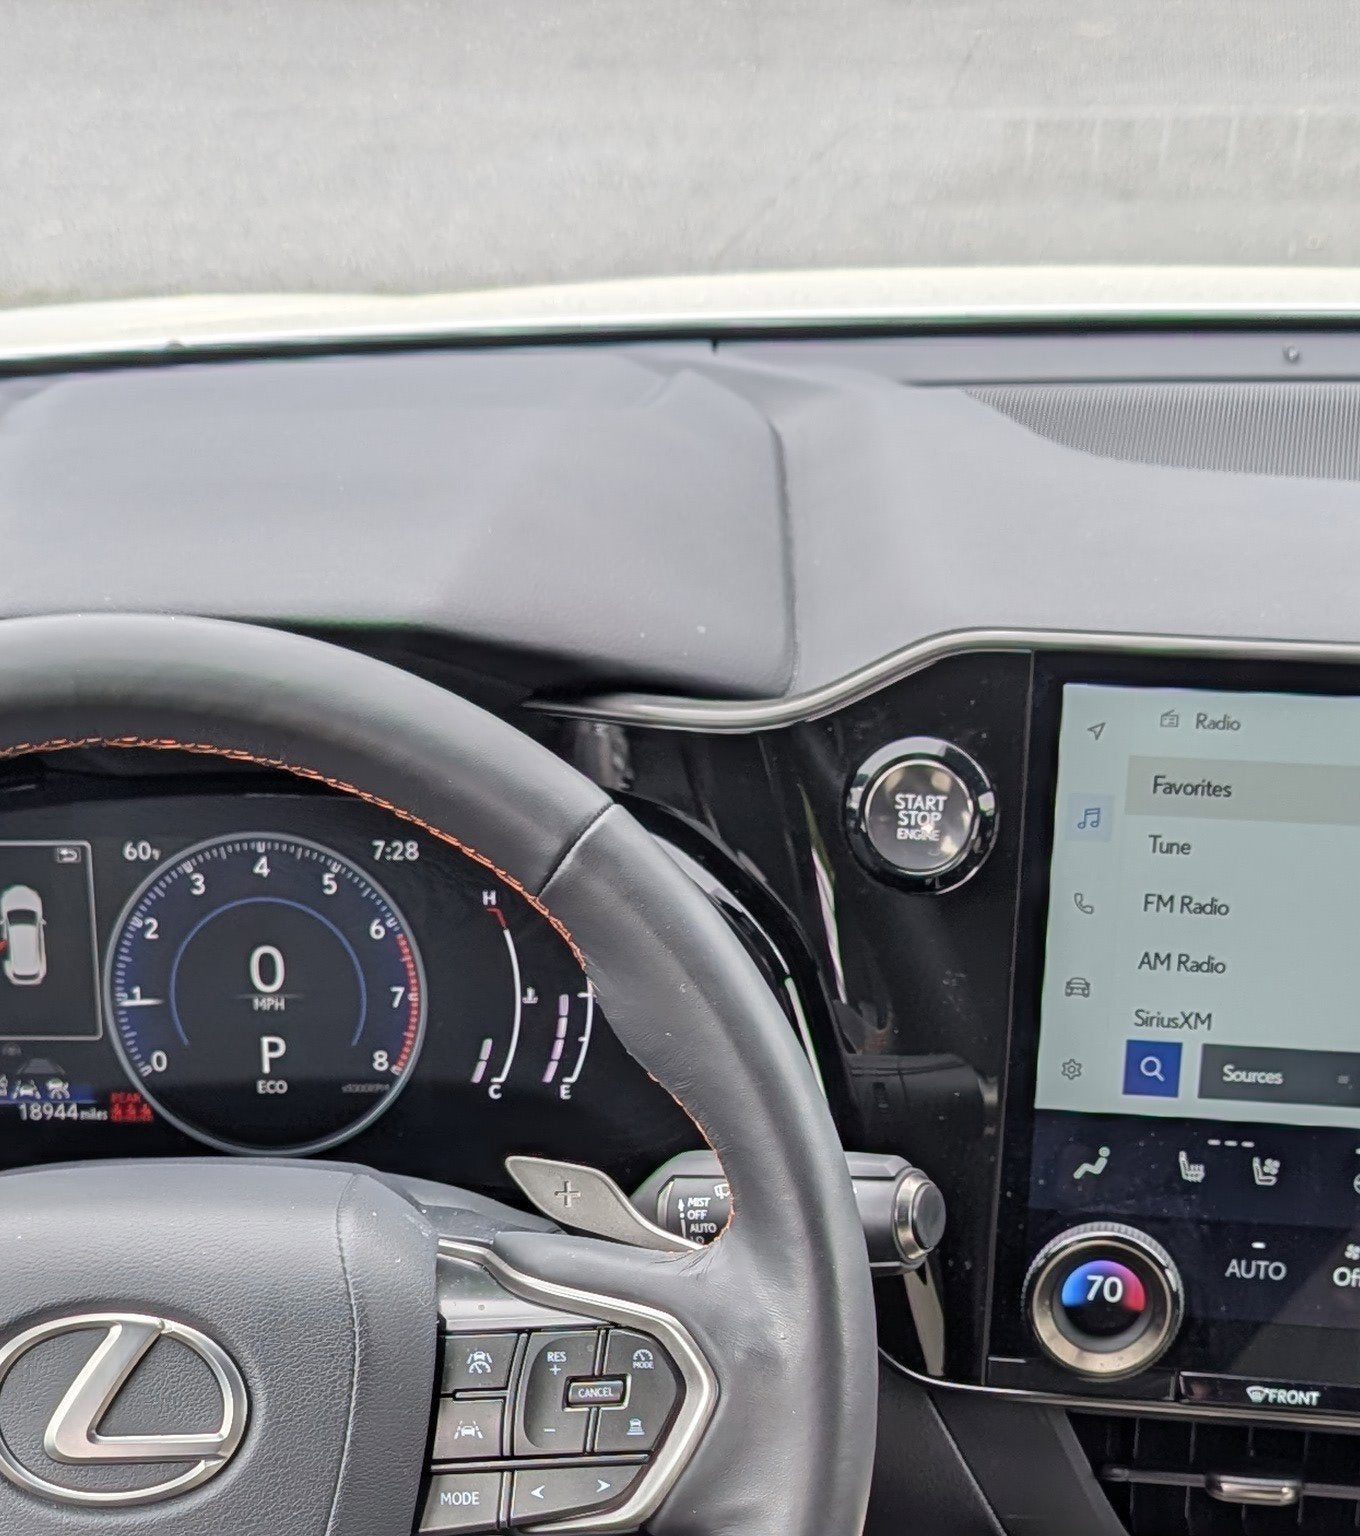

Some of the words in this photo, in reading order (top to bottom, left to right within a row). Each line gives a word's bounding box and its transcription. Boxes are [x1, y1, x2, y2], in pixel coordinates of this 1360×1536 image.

[1195, 712, 1242, 731] Radio
[1152, 775, 1233, 798] Favorites
[894, 793, 948, 812] START
[897, 810, 942, 827] STOP
[896, 828, 940, 842] ENGINE
[1148, 834, 1192, 855] Tune
[372, 840, 419, 861] 7:28
[252, 856, 270, 877] 4
[189, 873, 205, 895] 3
[322, 873, 338, 895] 5
[482, 889, 497, 905] H
[1143, 893, 1175, 914] FM
[1180, 896, 1230, 916] Radio
[144, 918, 159, 939] 2
[370, 919, 385, 940] 6
[249, 946, 285, 993] 0
[1138, 951, 1171, 971] AM
[1177, 953, 1227, 975] Radio
[133, 985, 142, 1002] 1
[390, 987, 405, 1008] 7
[252, 998, 285, 1011] MPH
[1134, 1009, 1213, 1031] SiriusXM
[150, 1051, 167, 1072] 0
[260, 1036, 286, 1074] P
[372, 1050, 389, 1071] 8
[1222, 1063, 1284, 1085] Sources
[256, 1080, 288, 1094] ECO
[489, 1084, 502, 1100] C
[560, 1084, 571, 1100] E
[19, 1103, 79, 1121] 18944
[80, 1107, 108, 1121] miles
[687, 1197, 711, 1207] MIST
[687, 1210, 708, 1220] OFF
[690, 1223, 717, 1233] AUTO
[1225, 1259, 1287, 1281] AUTO
[1086, 1274, 1123, 1303] 70
[547, 1351, 567, 1363] RES
[633, 1361, 654, 1370] MODE
[578, 1386, 614, 1398] CANCEL
[1268, 1389, 1321, 1406] FRONT
[440, 1491, 480, 1506] MODE
